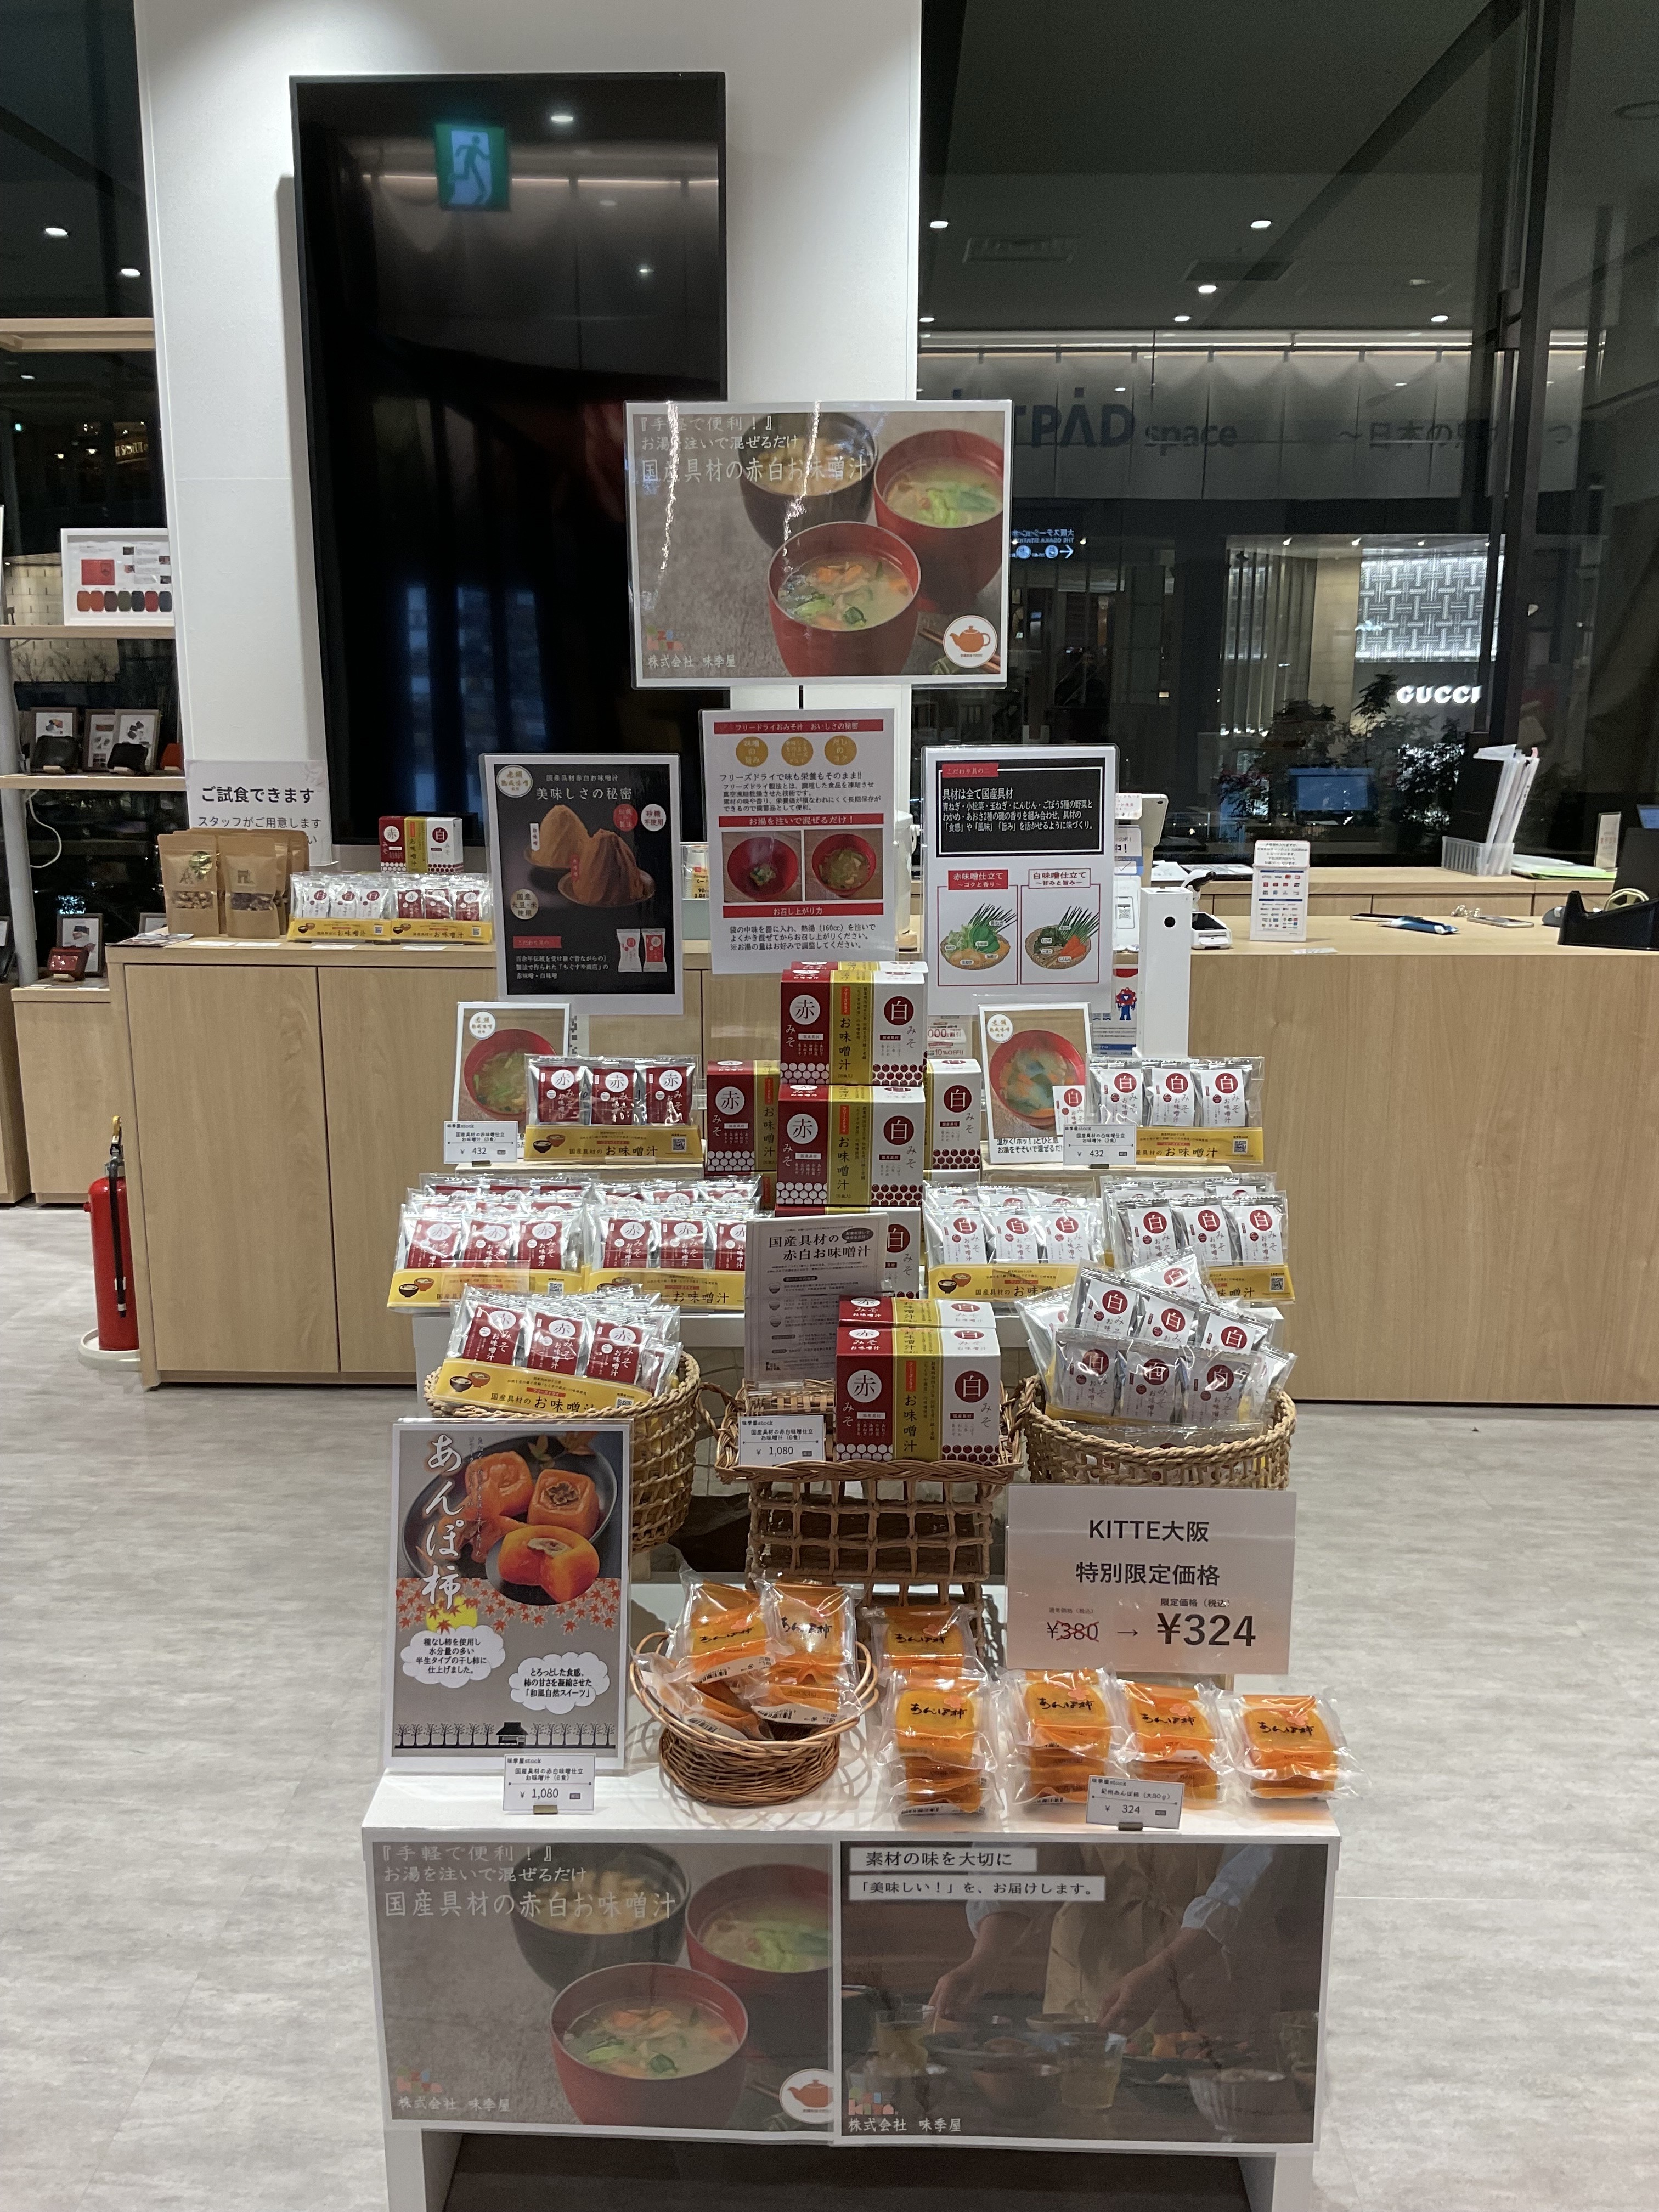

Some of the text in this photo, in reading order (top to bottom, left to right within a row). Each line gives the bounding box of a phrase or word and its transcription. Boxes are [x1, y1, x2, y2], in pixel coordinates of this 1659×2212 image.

[1145, 424, 1238, 456] space
[648, 655, 693, 669] 株式会社
[1397, 685, 1482, 704] GUCCI
[201, 786, 314, 803] ご試食できます
[537, 787, 632, 800] 美味しさの秘密
[942, 787, 1014, 800] 具材は全て国産具材
[199, 816, 321, 829] スタッフがご用意します
[953, 872, 1003, 881] 赤味噌仕立て
[1033, 871, 1087, 880] 白味噌仕立て
[773, 907, 823, 916] お召し上がり方
[795, 999, 815, 1019] 赤
[891, 1000, 907, 1020] 白
[786, 1024, 795, 1047] みそ
[906, 1026, 916, 1048] みそ
[839, 1018, 851, 1070] お味噌汁
[555, 1071, 570, 1085] 赤
[609, 1075, 624, 1088] 赤
[663, 1072, 678, 1086] 赤
[1119, 1076, 1132, 1090] 白
[1171, 1076, 1184, 1090] 白
[1221, 1076, 1234, 1091] 白
[720, 1091, 740, 1109] 赤
[951, 1089, 966, 1109] 白
[712, 1114, 722, 1136] みそ
[793, 1118, 812, 1138] 赤
[891, 1120, 908, 1141] 白
[965, 1113, 974, 1133] みそ
[764, 1108, 775, 1157] お味噌汁
[606, 1146, 658, 1156] お味噌汁
[782, 1143, 793, 1167] みそ
[906, 1146, 917, 1169] みそ
[1165, 1147, 1218, 1158] お味噌汁
[837, 1137, 849, 1190] お味噌汁
[1012, 1221, 1024, 1232] 白
[1148, 1215, 1163, 1230] 白
[1202, 1213, 1216, 1228] 白
[1254, 1213, 1267, 1227] 白
[537, 1224, 552, 1235] 赤
[625, 1224, 641, 1235] 赤
[634, 1239, 643, 1257] みそ
[769, 1234, 839, 1248] 国産具材の
[783, 1245, 871, 1261] 赤白お味噌汁
[903, 1254, 913, 1276] みそ
[674, 1292, 729, 1304] お味噌汁
[1108, 1294, 1122, 1312] 白
[554, 1322, 571, 1335] 赤
[1165, 1312, 1181, 1330] 白
[614, 1330, 631, 1342] 赤
[1226, 1330, 1242, 1348] 白
[621, 1346, 634, 1368] みそ
[854, 1375, 876, 1396] 赤
[963, 1375, 981, 1397] 白
[490, 1392, 531, 1406] 国産具材の
[843, 1402, 854, 1426] みそ
[980, 1403, 992, 1427] みそ
[904, 1395, 917, 1452] お味噌汁
[769, 1446, 793, 1457] 1,080
[421, 1434, 464, 1610] あんぽ柿
[1089, 1520, 1210, 1542] KITTE大阪
[1076, 1562, 1220, 1586] 特別限定価格
[1047, 1613, 1256, 1646] ¥380 ¥324
[424, 1638, 481, 1646] 種なし柿を使用し
[895, 1633, 948, 1644] あんぽ柿
[429, 1647, 475, 1655] 水分量の多い
[416, 1656, 487, 1665] 半生タイプの干し柿に
[428, 1666, 475, 1675] 仕上げました。
[531, 1668, 584, 1677] とろっとした食感、
[523, 1678, 592, 1688] 柿の甘さを凝縮させた
[526, 1689, 591, 1699] 「和風自然スイーツ」
[910, 1703, 968, 1719] あんぽ柿
[1037, 1697, 1094, 1711] あんぽ柿
[1140, 1713, 1197, 1725] あんぽ柿
[1257, 1721, 1314, 1736] あんぽ柿
[532, 1788, 558, 1799] 1,080
[1121, 1804, 1140, 1814] 324
[381, 1845, 553, 1863] 『手軽で便利！』
[865, 1851, 1013, 1867] 素材の味を大切に
[385, 1866, 587, 1883] お湯を注いで混ぜるだけ
[860, 1880, 1094, 1896] 「美味しい！」を、お届けします。
[385, 1891, 676, 1918] 国産具材の赤白お味噌汁
[398, 2096, 510, 2112] 株式会社 味季屋
[848, 2117, 961, 2132] 株式会社 味季屋
